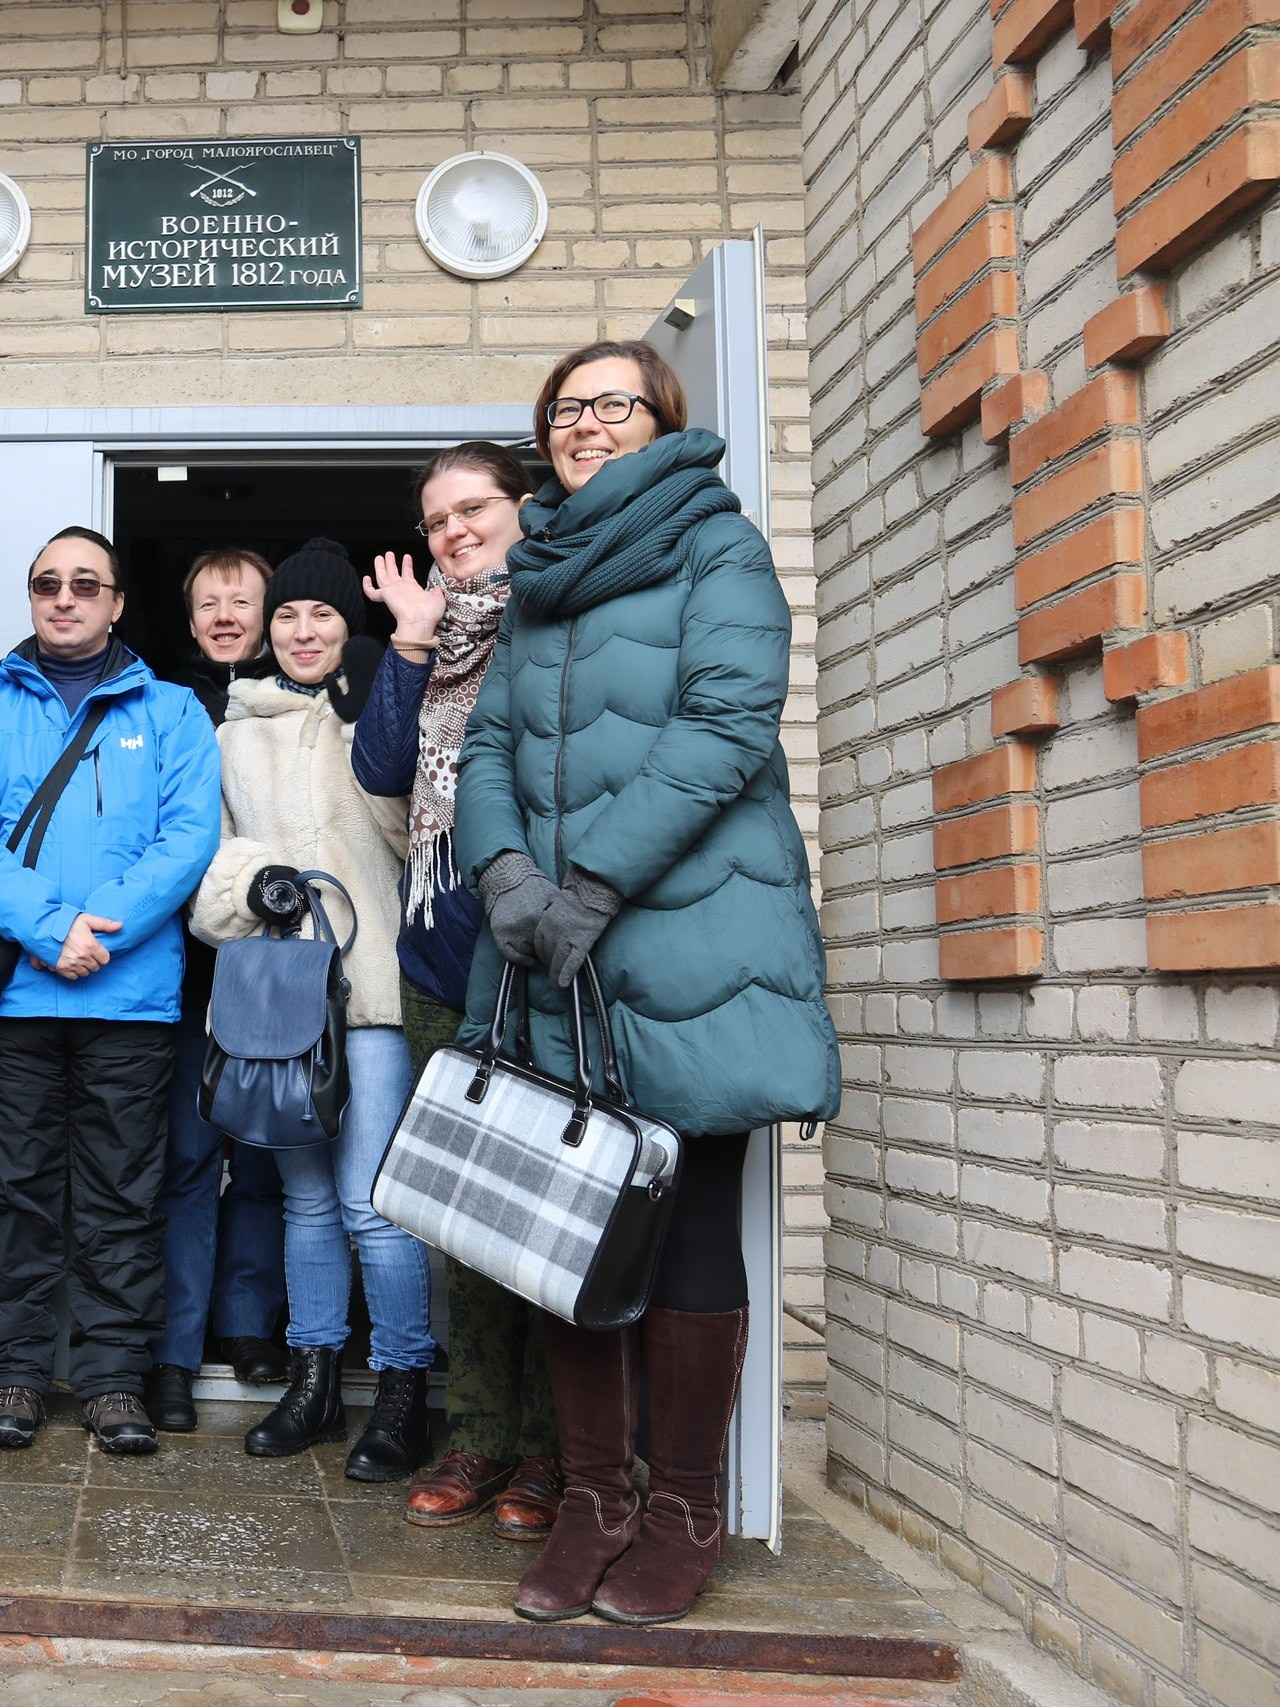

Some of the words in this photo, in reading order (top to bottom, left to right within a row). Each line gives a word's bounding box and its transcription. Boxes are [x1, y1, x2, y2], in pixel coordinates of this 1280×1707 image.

[113, 150, 137, 160] МО
[212, 188, 233, 198] 1812
[160, 214, 299, 235] ВОЕННО-
[108, 232, 340, 260] ИСТОРИЧЕСКИЙ
[101, 258, 217, 289] МУЗЕЙ
[231, 261, 285, 286] 1812
